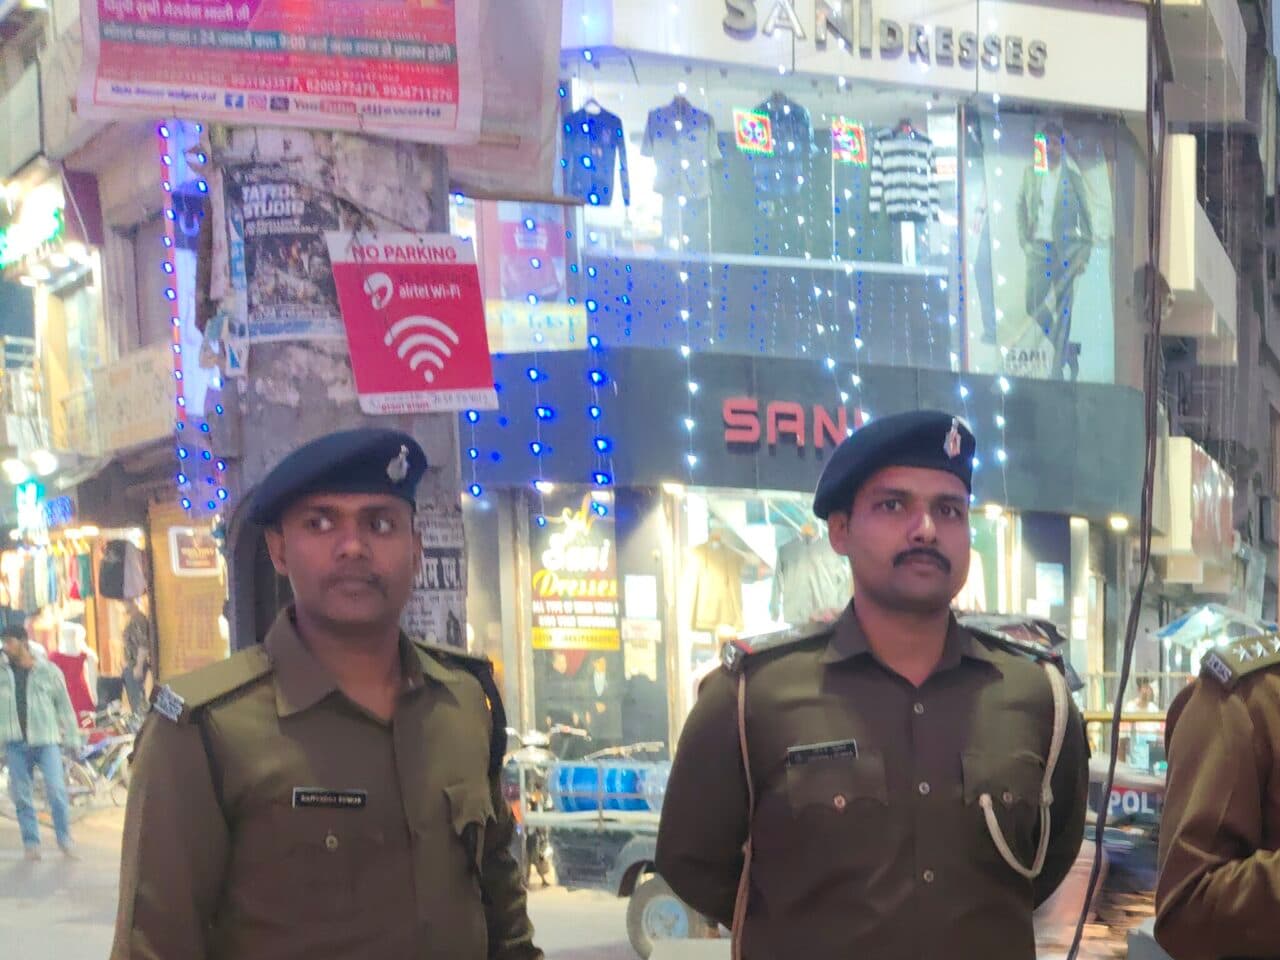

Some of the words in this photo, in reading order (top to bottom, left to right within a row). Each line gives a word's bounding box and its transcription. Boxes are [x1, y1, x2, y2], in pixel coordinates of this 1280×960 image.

[723, 0, 873, 59] SANI
[880, 18, 1048, 77] DRESSES
[352, 246, 380, 262] NO
[384, 246, 458, 264] PARKING
[399, 282, 430, 299] airtel
[1107, 789, 1160, 816] POL
